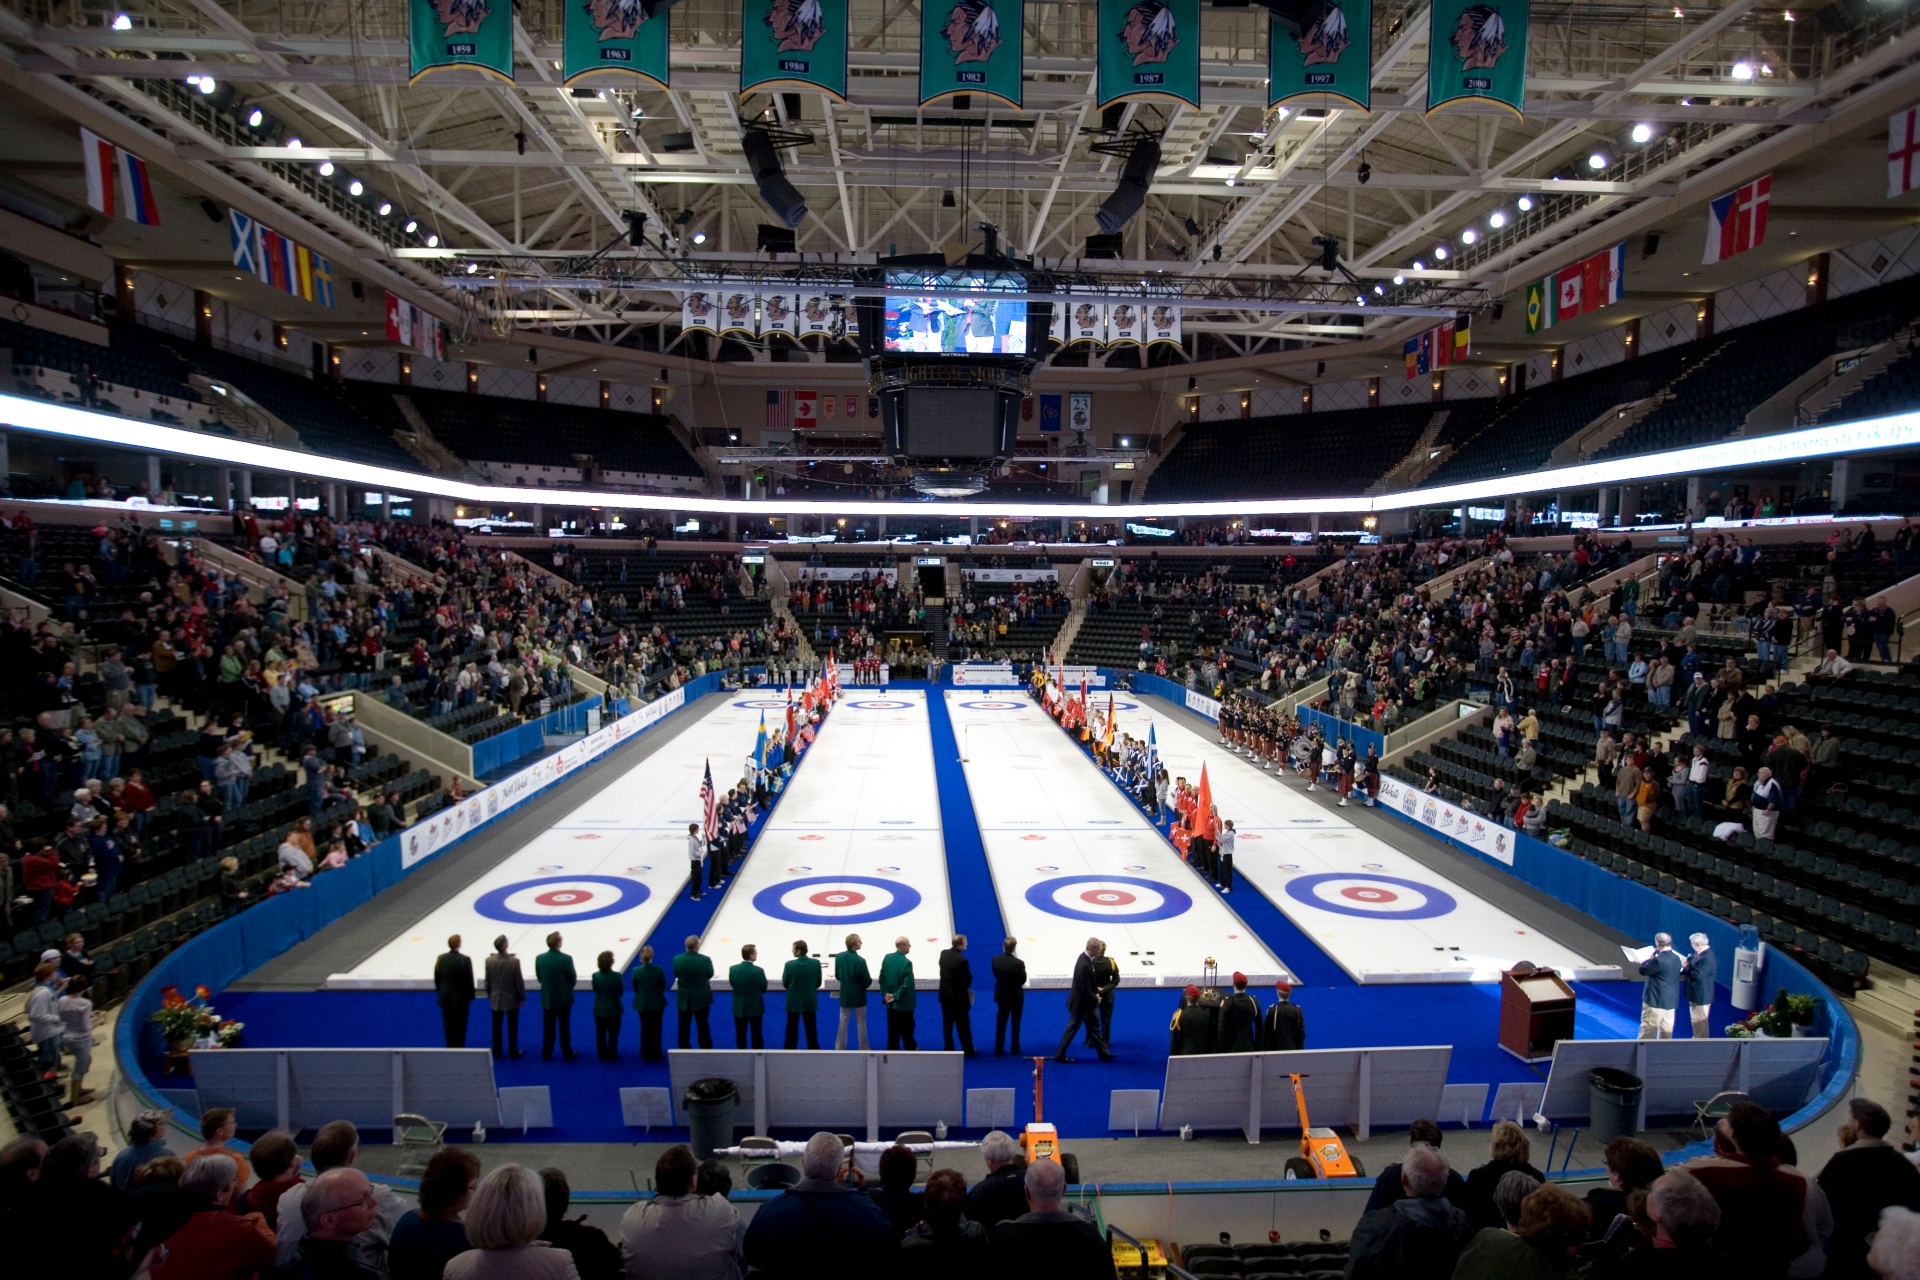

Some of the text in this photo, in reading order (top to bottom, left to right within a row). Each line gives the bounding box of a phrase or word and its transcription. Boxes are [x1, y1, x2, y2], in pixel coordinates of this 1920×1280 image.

[452, 45, 472, 55] 1959
[605, 50, 627, 60] 1963
[784, 61, 805, 71] 1980
[962, 73, 981, 82] 1982
[1139, 74, 1159, 83] 1987
[1310, 75, 1330, 84] 1997
[1468, 79, 1487, 89] 2000
[1073, 398, 1088, 410] 23
[1751, 424, 1919, 458] Verdensmesterskape
[1403, 795, 1417, 808] GRAND
[1423, 805, 1437, 818] GRAND
[1422, 815, 1436, 827] FORKS
